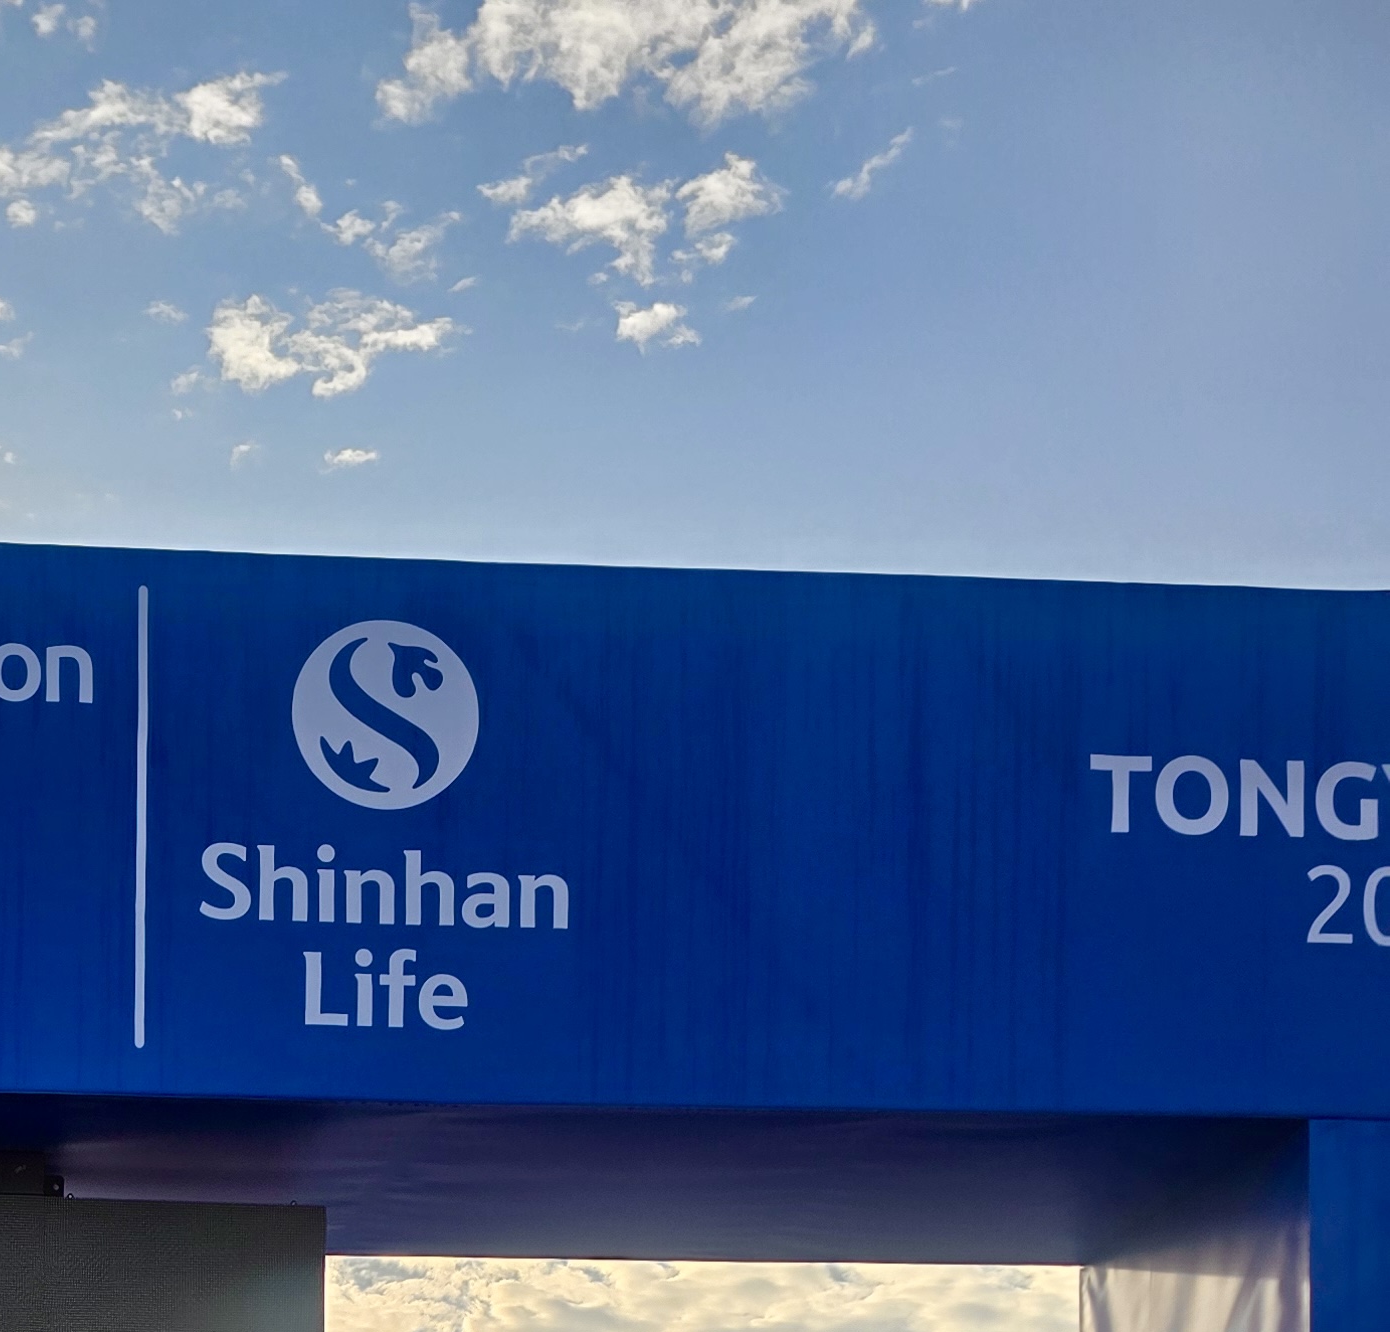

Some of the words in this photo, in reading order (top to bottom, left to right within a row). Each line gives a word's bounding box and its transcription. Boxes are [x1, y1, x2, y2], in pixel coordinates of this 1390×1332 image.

[1089, 753, 1390, 841] TONG
[199, 842, 569, 930] Shinhan
[303, 948, 469, 1031] Life
